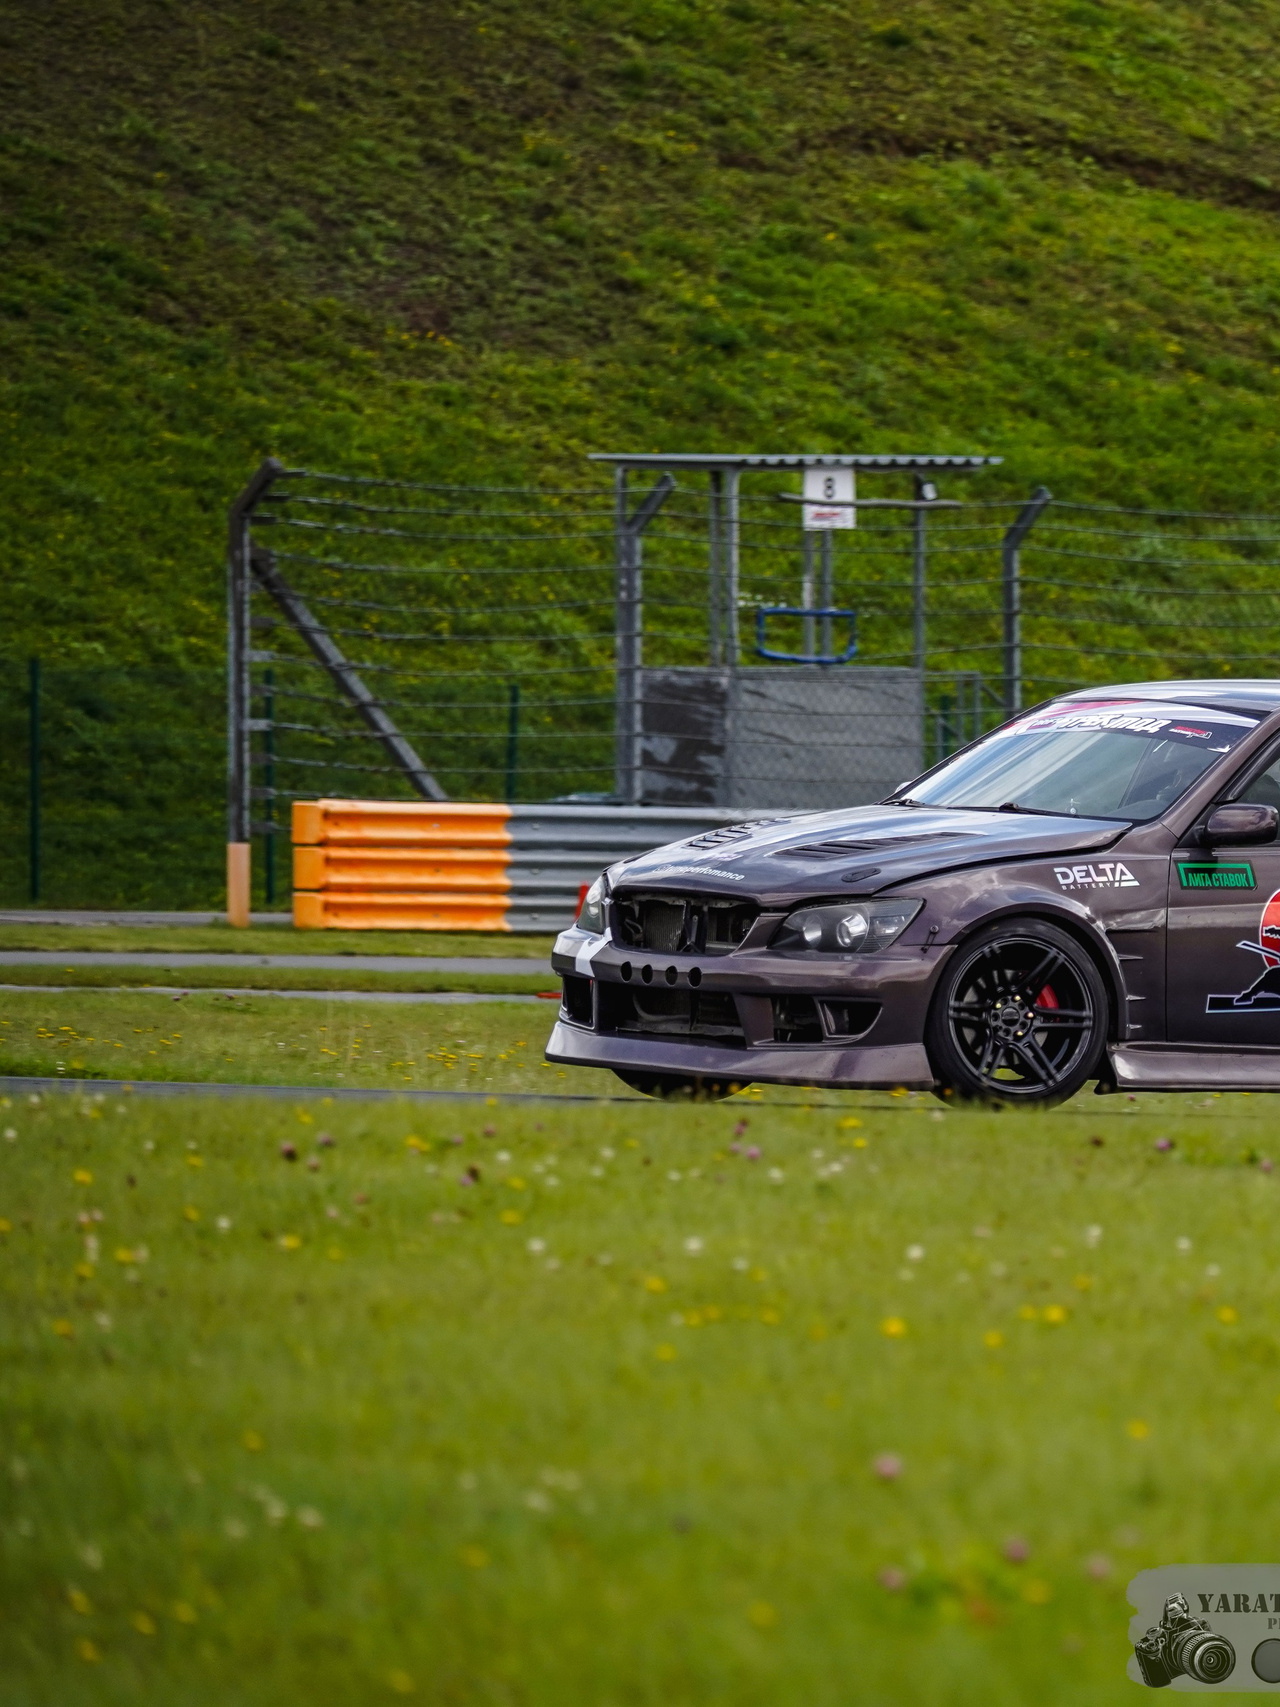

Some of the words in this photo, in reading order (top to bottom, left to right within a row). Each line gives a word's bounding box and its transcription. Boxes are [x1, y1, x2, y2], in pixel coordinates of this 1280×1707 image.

[823, 476, 836, 499] 8
[1053, 862, 1139, 887] DELTA
[1188, 873, 1212, 887] ЛИГА
[1212, 873, 1249, 887] СТАВОК
[1062, 882, 1112, 890] BATTERY
